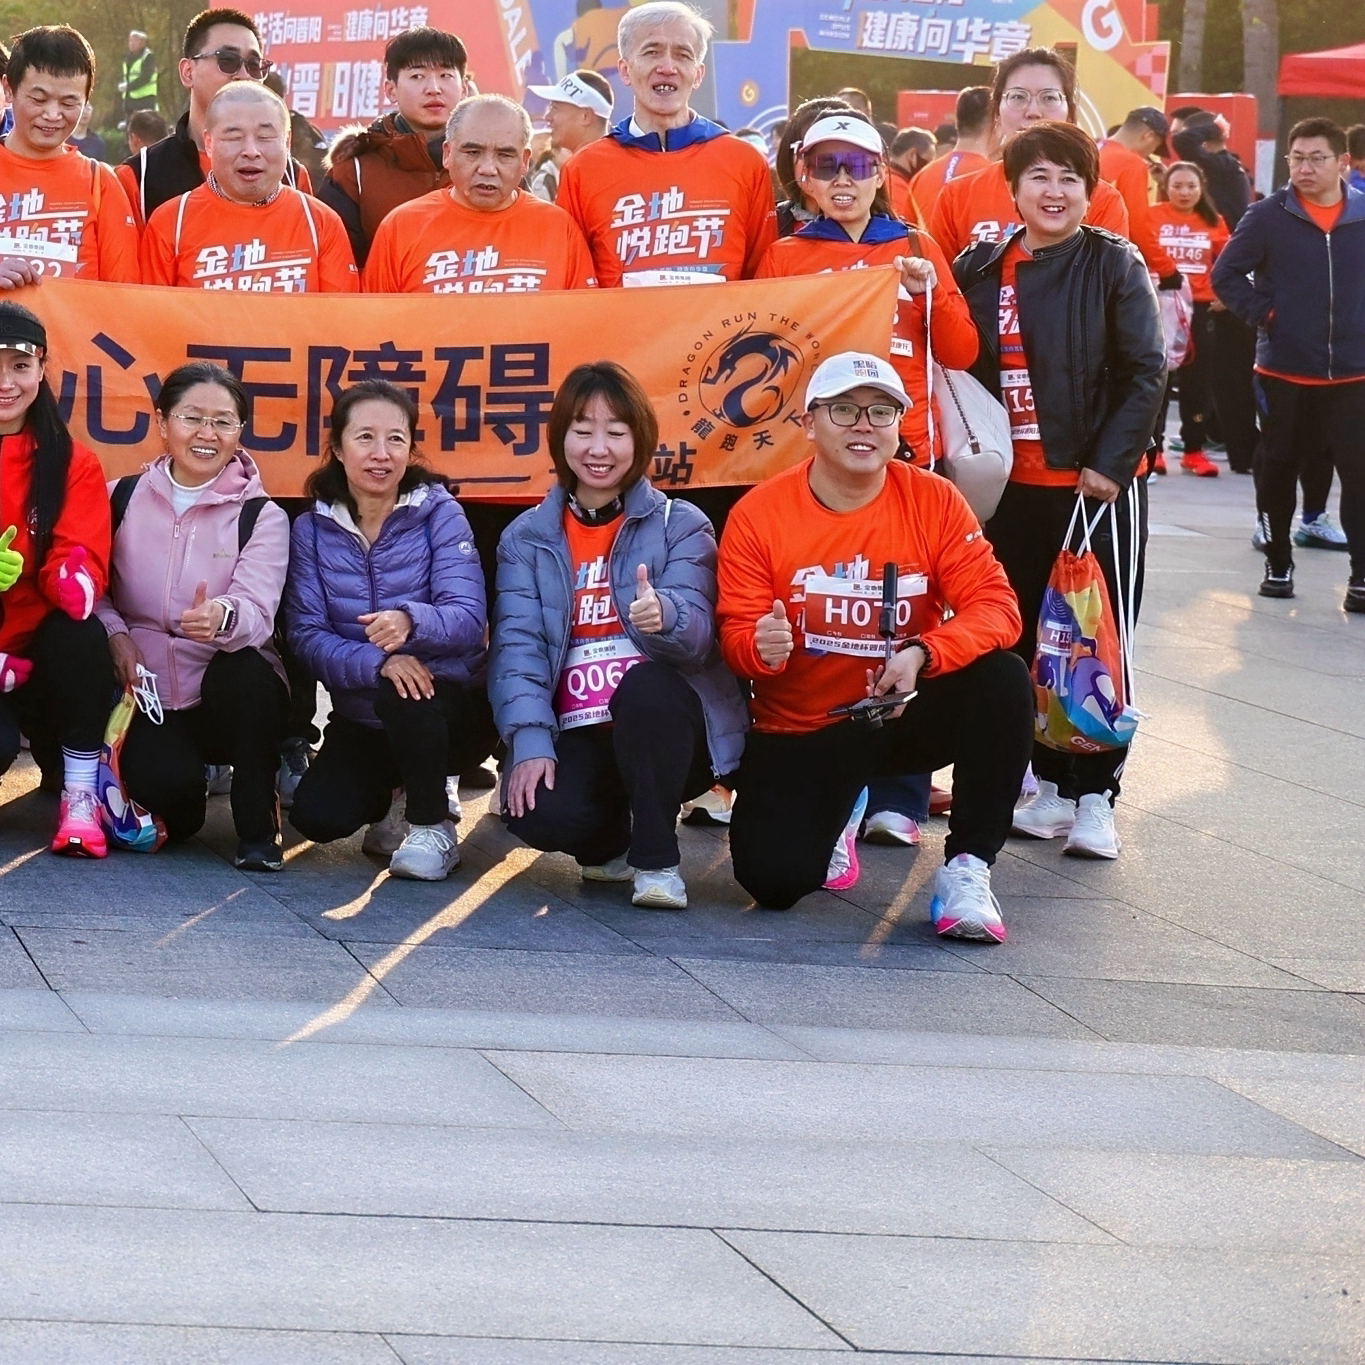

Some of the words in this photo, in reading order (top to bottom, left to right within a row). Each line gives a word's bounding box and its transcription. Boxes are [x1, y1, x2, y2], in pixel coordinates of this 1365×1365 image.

[610, 185, 731, 229] 金地
[193, 238, 312, 279] 金地
[616, 216, 725, 266] 悦跑节
[1166, 247, 1203, 261] H146
[422, 244, 547, 285] 金地
[678, 330, 714, 403] DRAGON
[721, 312, 757, 328] RUN
[769, 313, 800, 331] THE
[825, 597, 912, 627] H00
